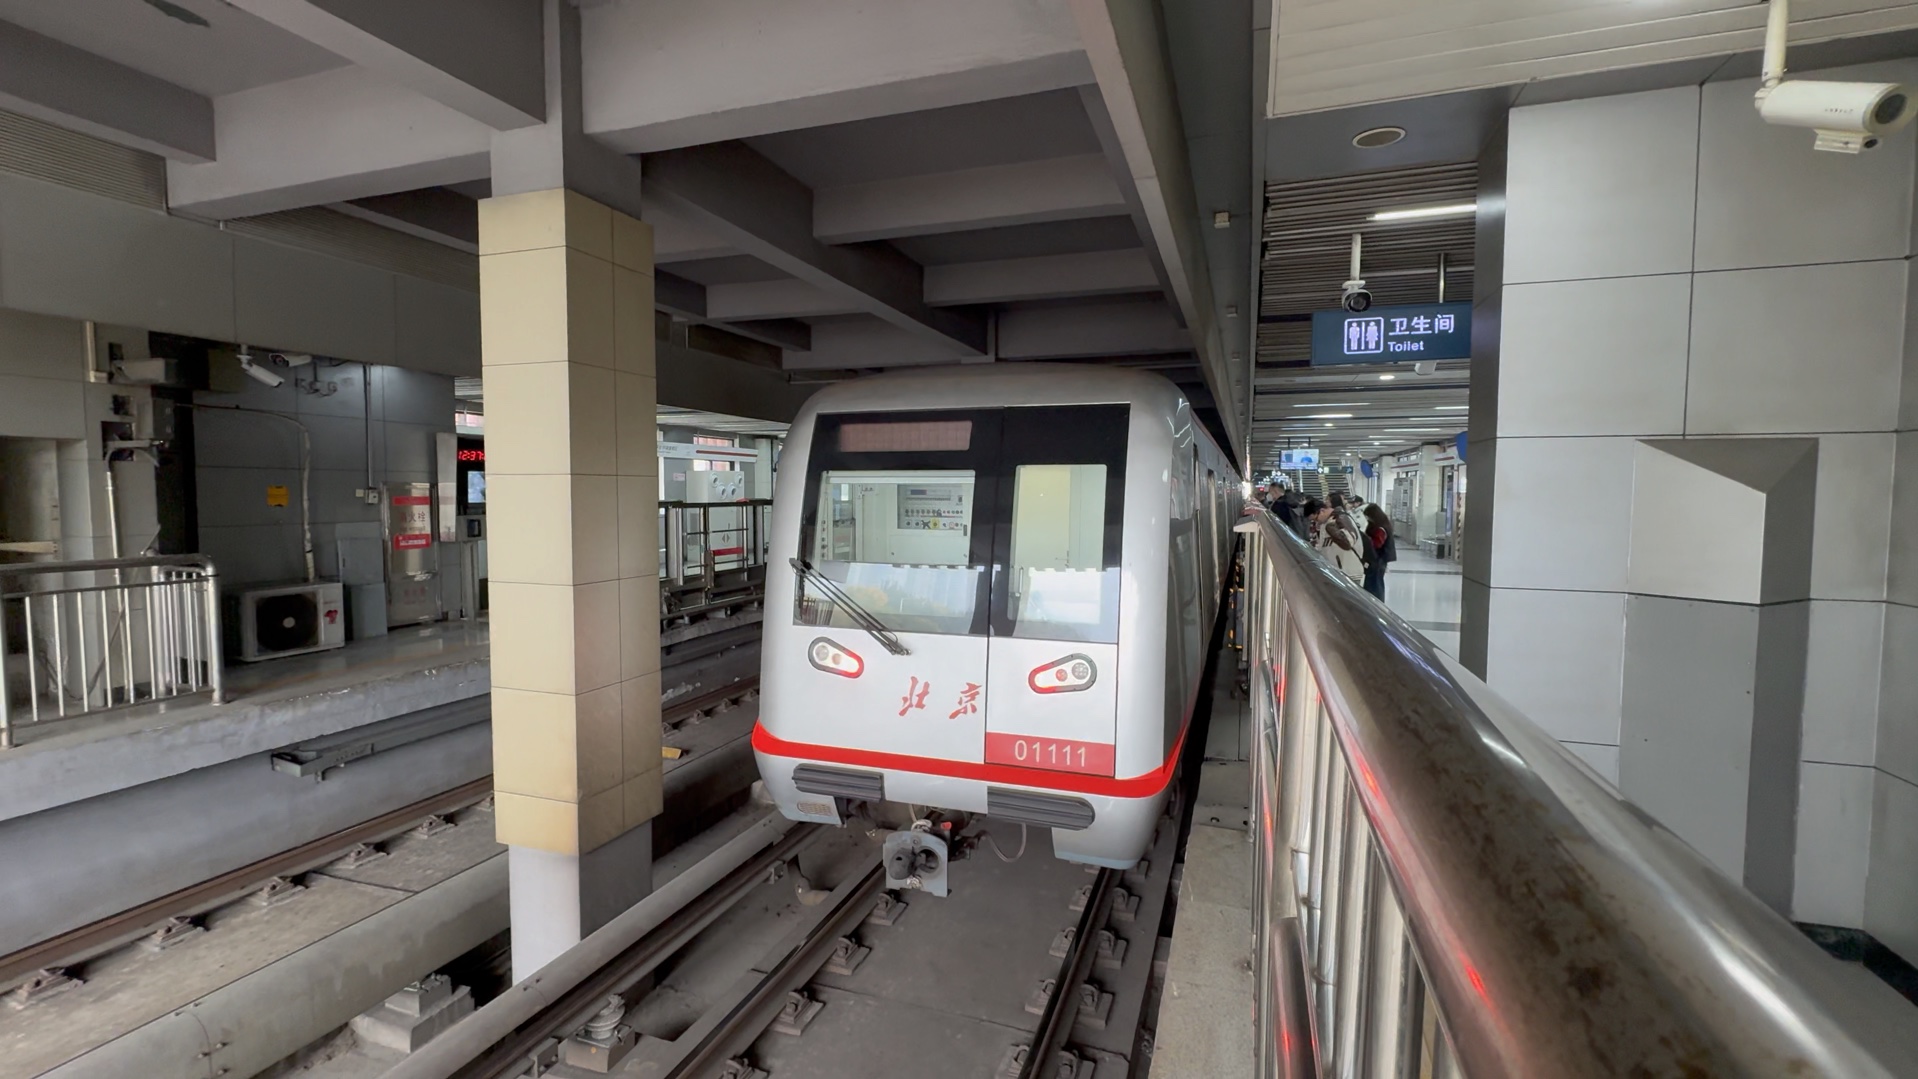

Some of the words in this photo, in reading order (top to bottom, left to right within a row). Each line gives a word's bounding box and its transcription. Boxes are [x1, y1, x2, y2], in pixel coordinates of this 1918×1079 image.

[1388, 314, 1455, 336] 卫生间
[1387, 340, 1425, 352] Toilet
[458, 450, 486, 461] 12:37:
[898, 676, 982, 720] 北京
[1014, 739, 1087, 768] 01111
